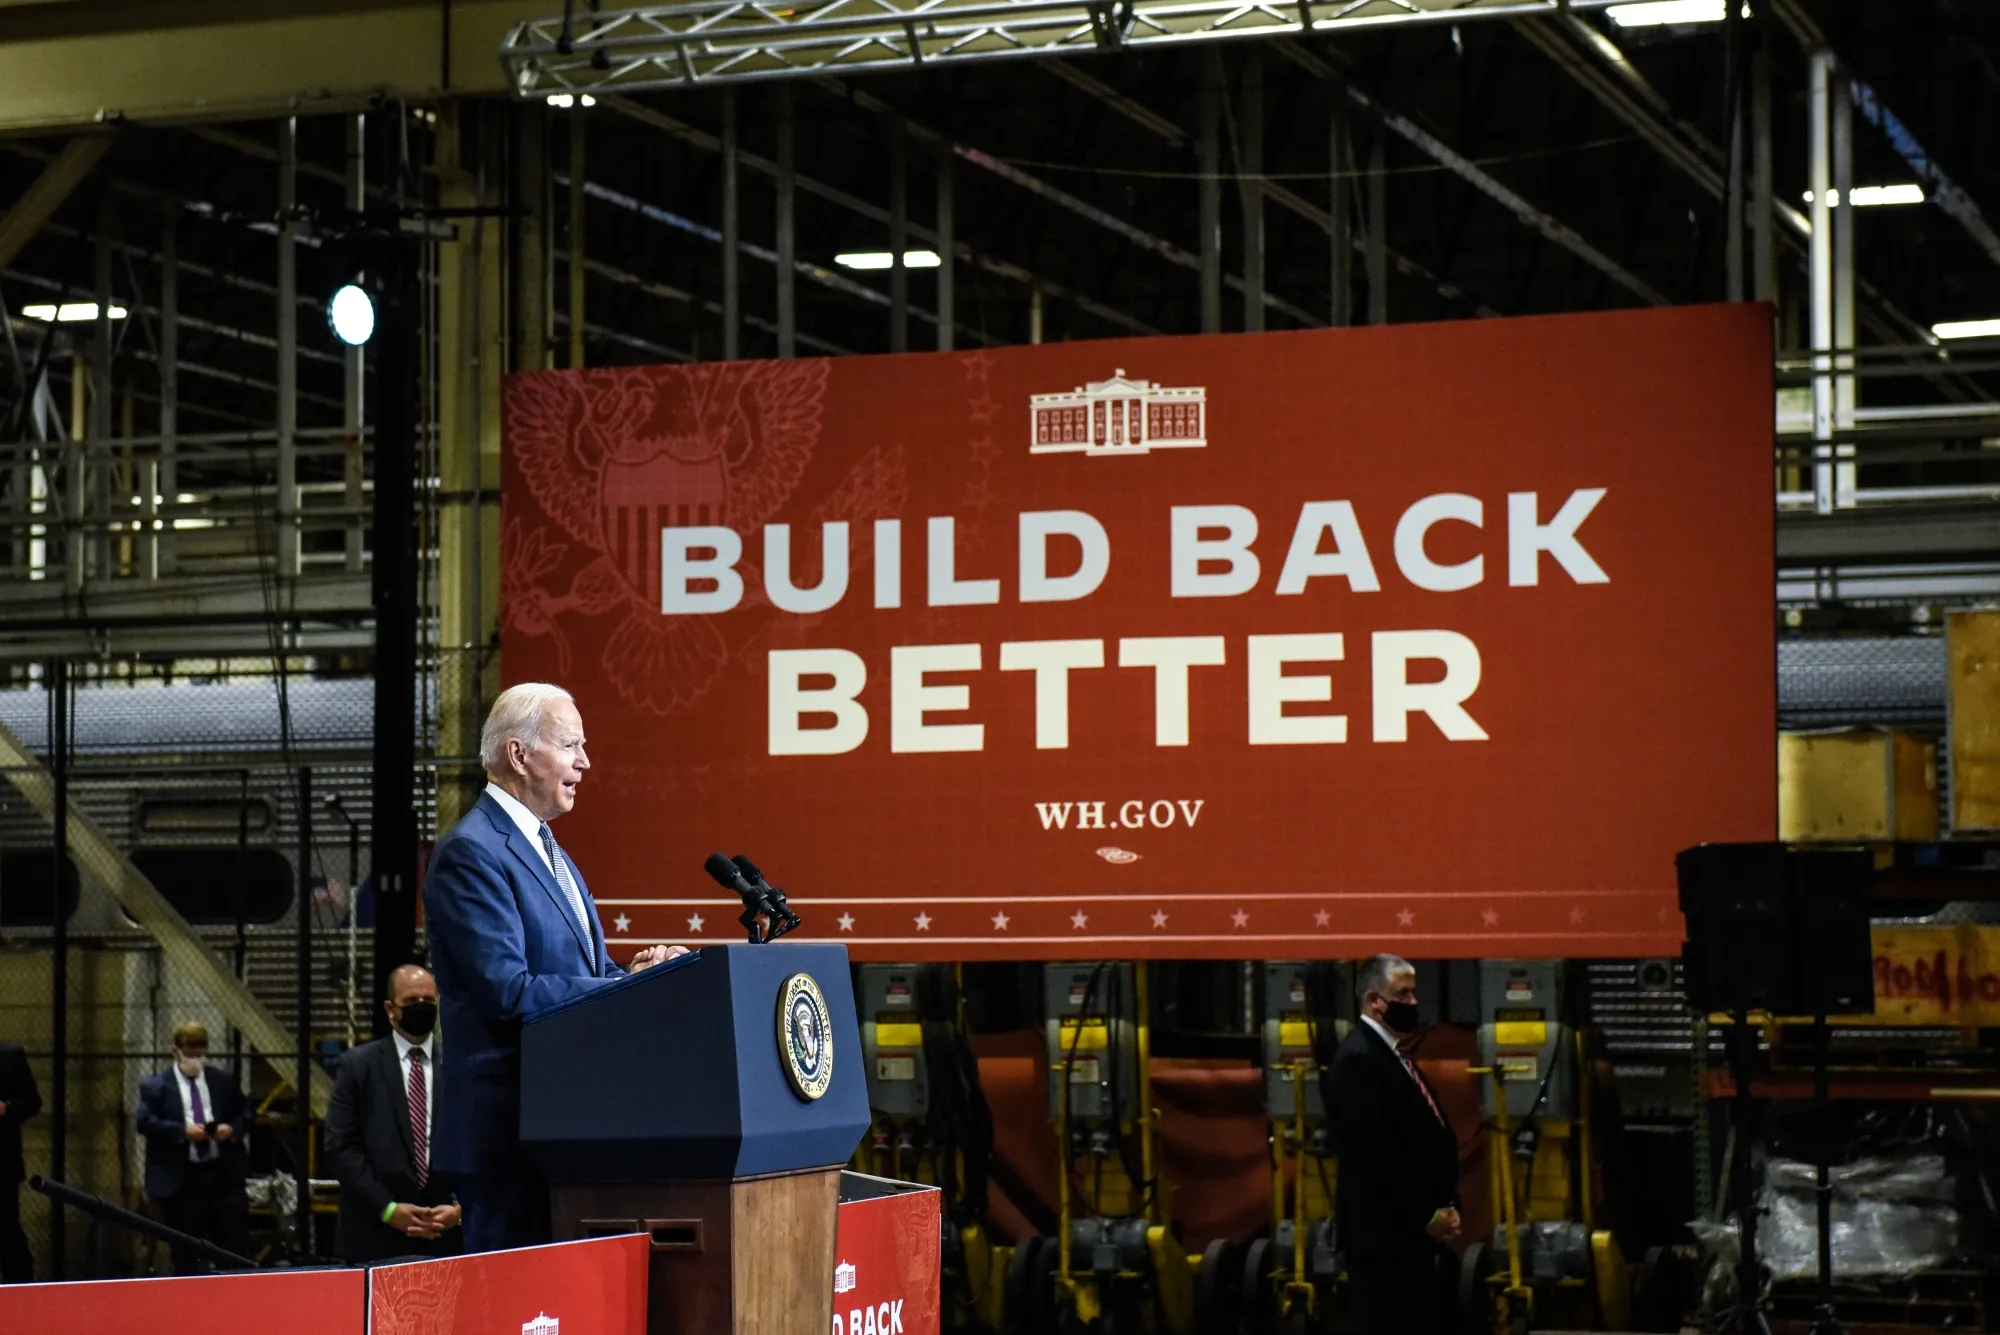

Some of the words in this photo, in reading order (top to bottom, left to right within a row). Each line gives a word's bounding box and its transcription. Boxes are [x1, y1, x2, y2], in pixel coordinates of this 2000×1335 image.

[661, 510, 1110, 615] BUILD
[1170, 487, 1610, 598] BACK
[768, 629, 1489, 756] BETTER
[1035, 799, 1204, 830] WH.GOV
[849, 1298, 904, 1335] BACK
